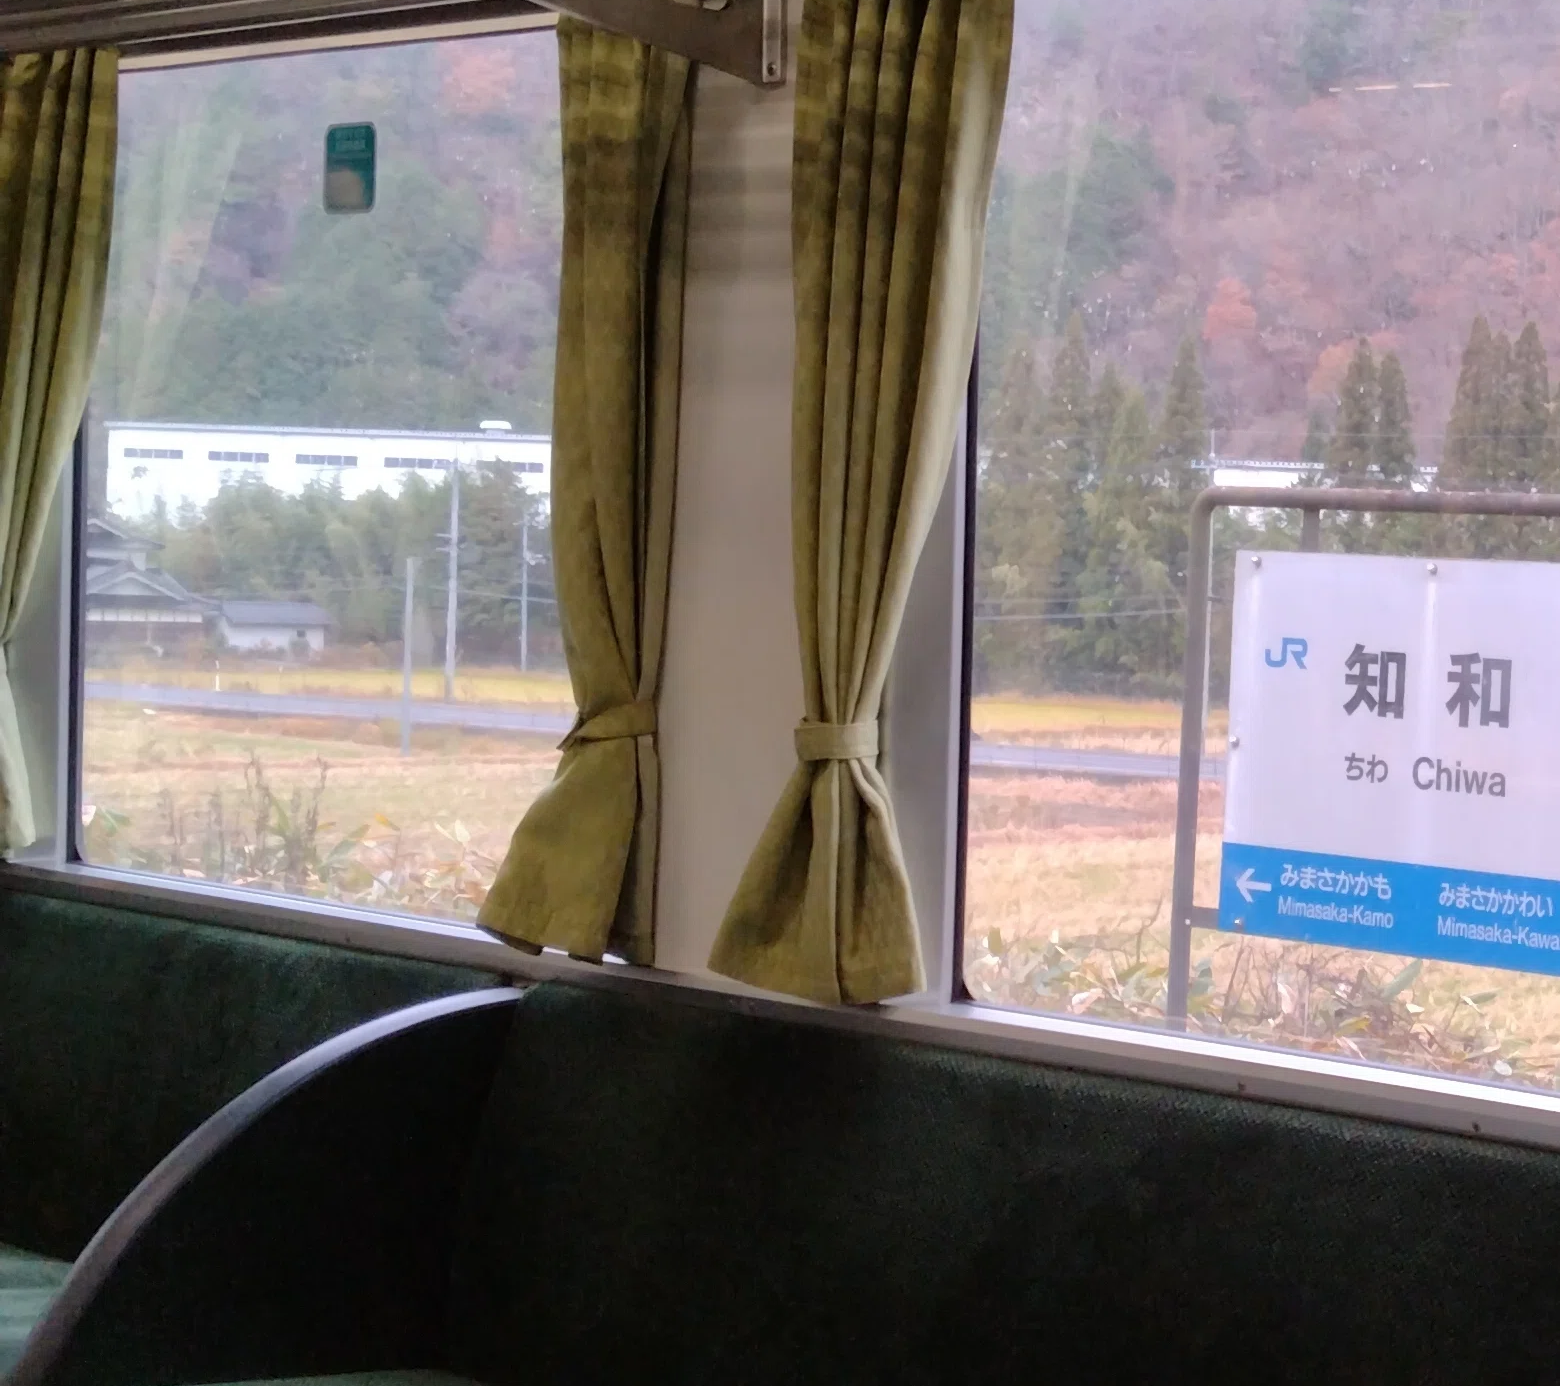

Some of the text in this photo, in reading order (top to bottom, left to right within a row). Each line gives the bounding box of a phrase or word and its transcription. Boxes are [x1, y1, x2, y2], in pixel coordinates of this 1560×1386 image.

[1264, 636, 1308, 670] JR
[1342, 643, 1513, 729] 知和
[1344, 751, 1507, 798] ちわ Chiwa
[1279, 863, 1393, 901] みまさかかも
[1438, 882, 1555, 918] みまさかかわい
[1277, 895, 1395, 930] Mimasaka-Kamo
